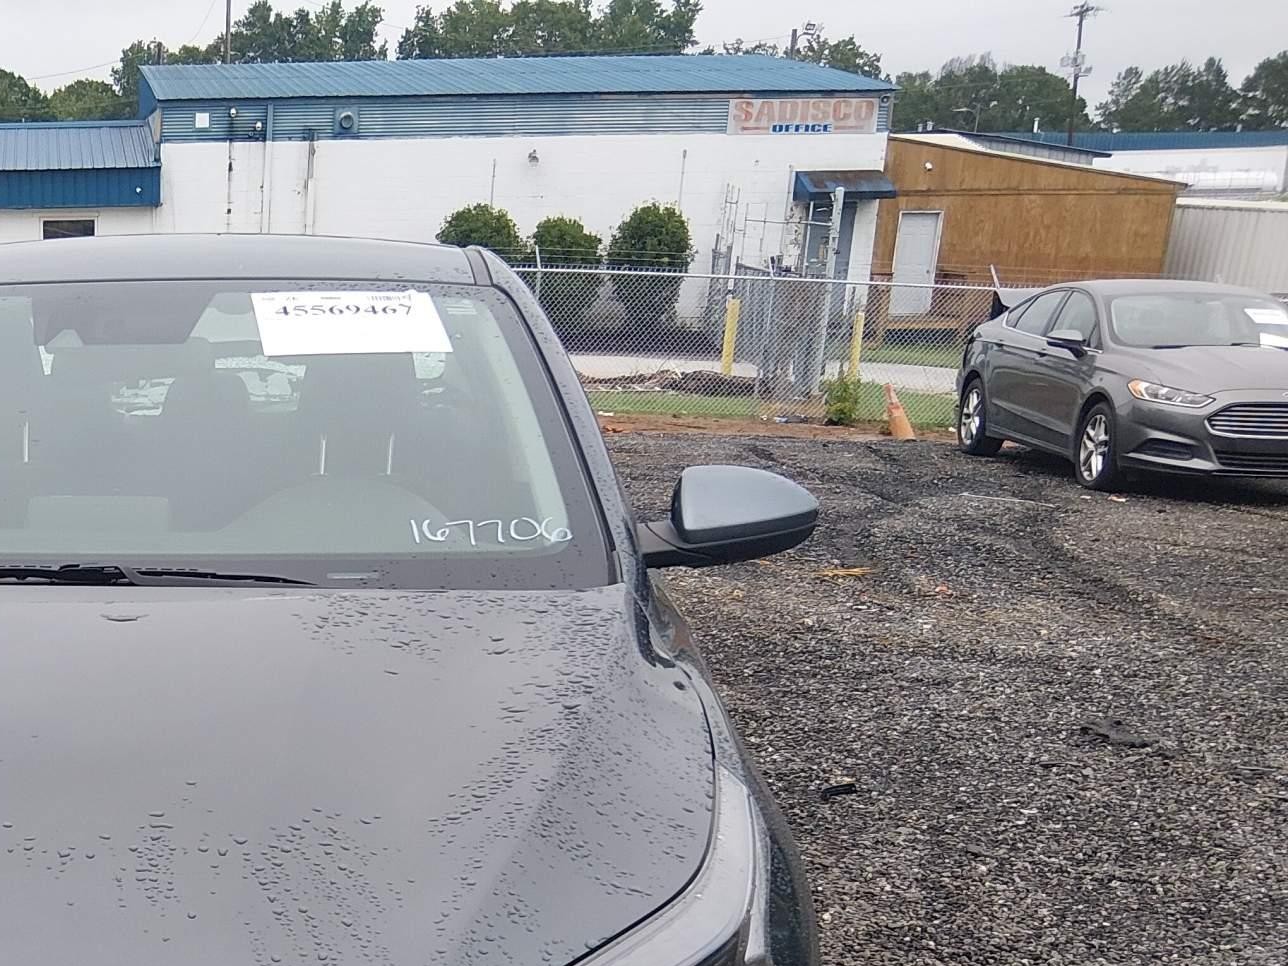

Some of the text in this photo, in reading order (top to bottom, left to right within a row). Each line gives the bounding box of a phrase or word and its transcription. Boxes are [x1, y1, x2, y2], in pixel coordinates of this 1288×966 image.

[733, 100, 875, 122] SADISCO
[771, 123, 834, 134] OFFICE
[274, 303, 413, 317] 45569467
[410, 516, 574, 547] 167706
